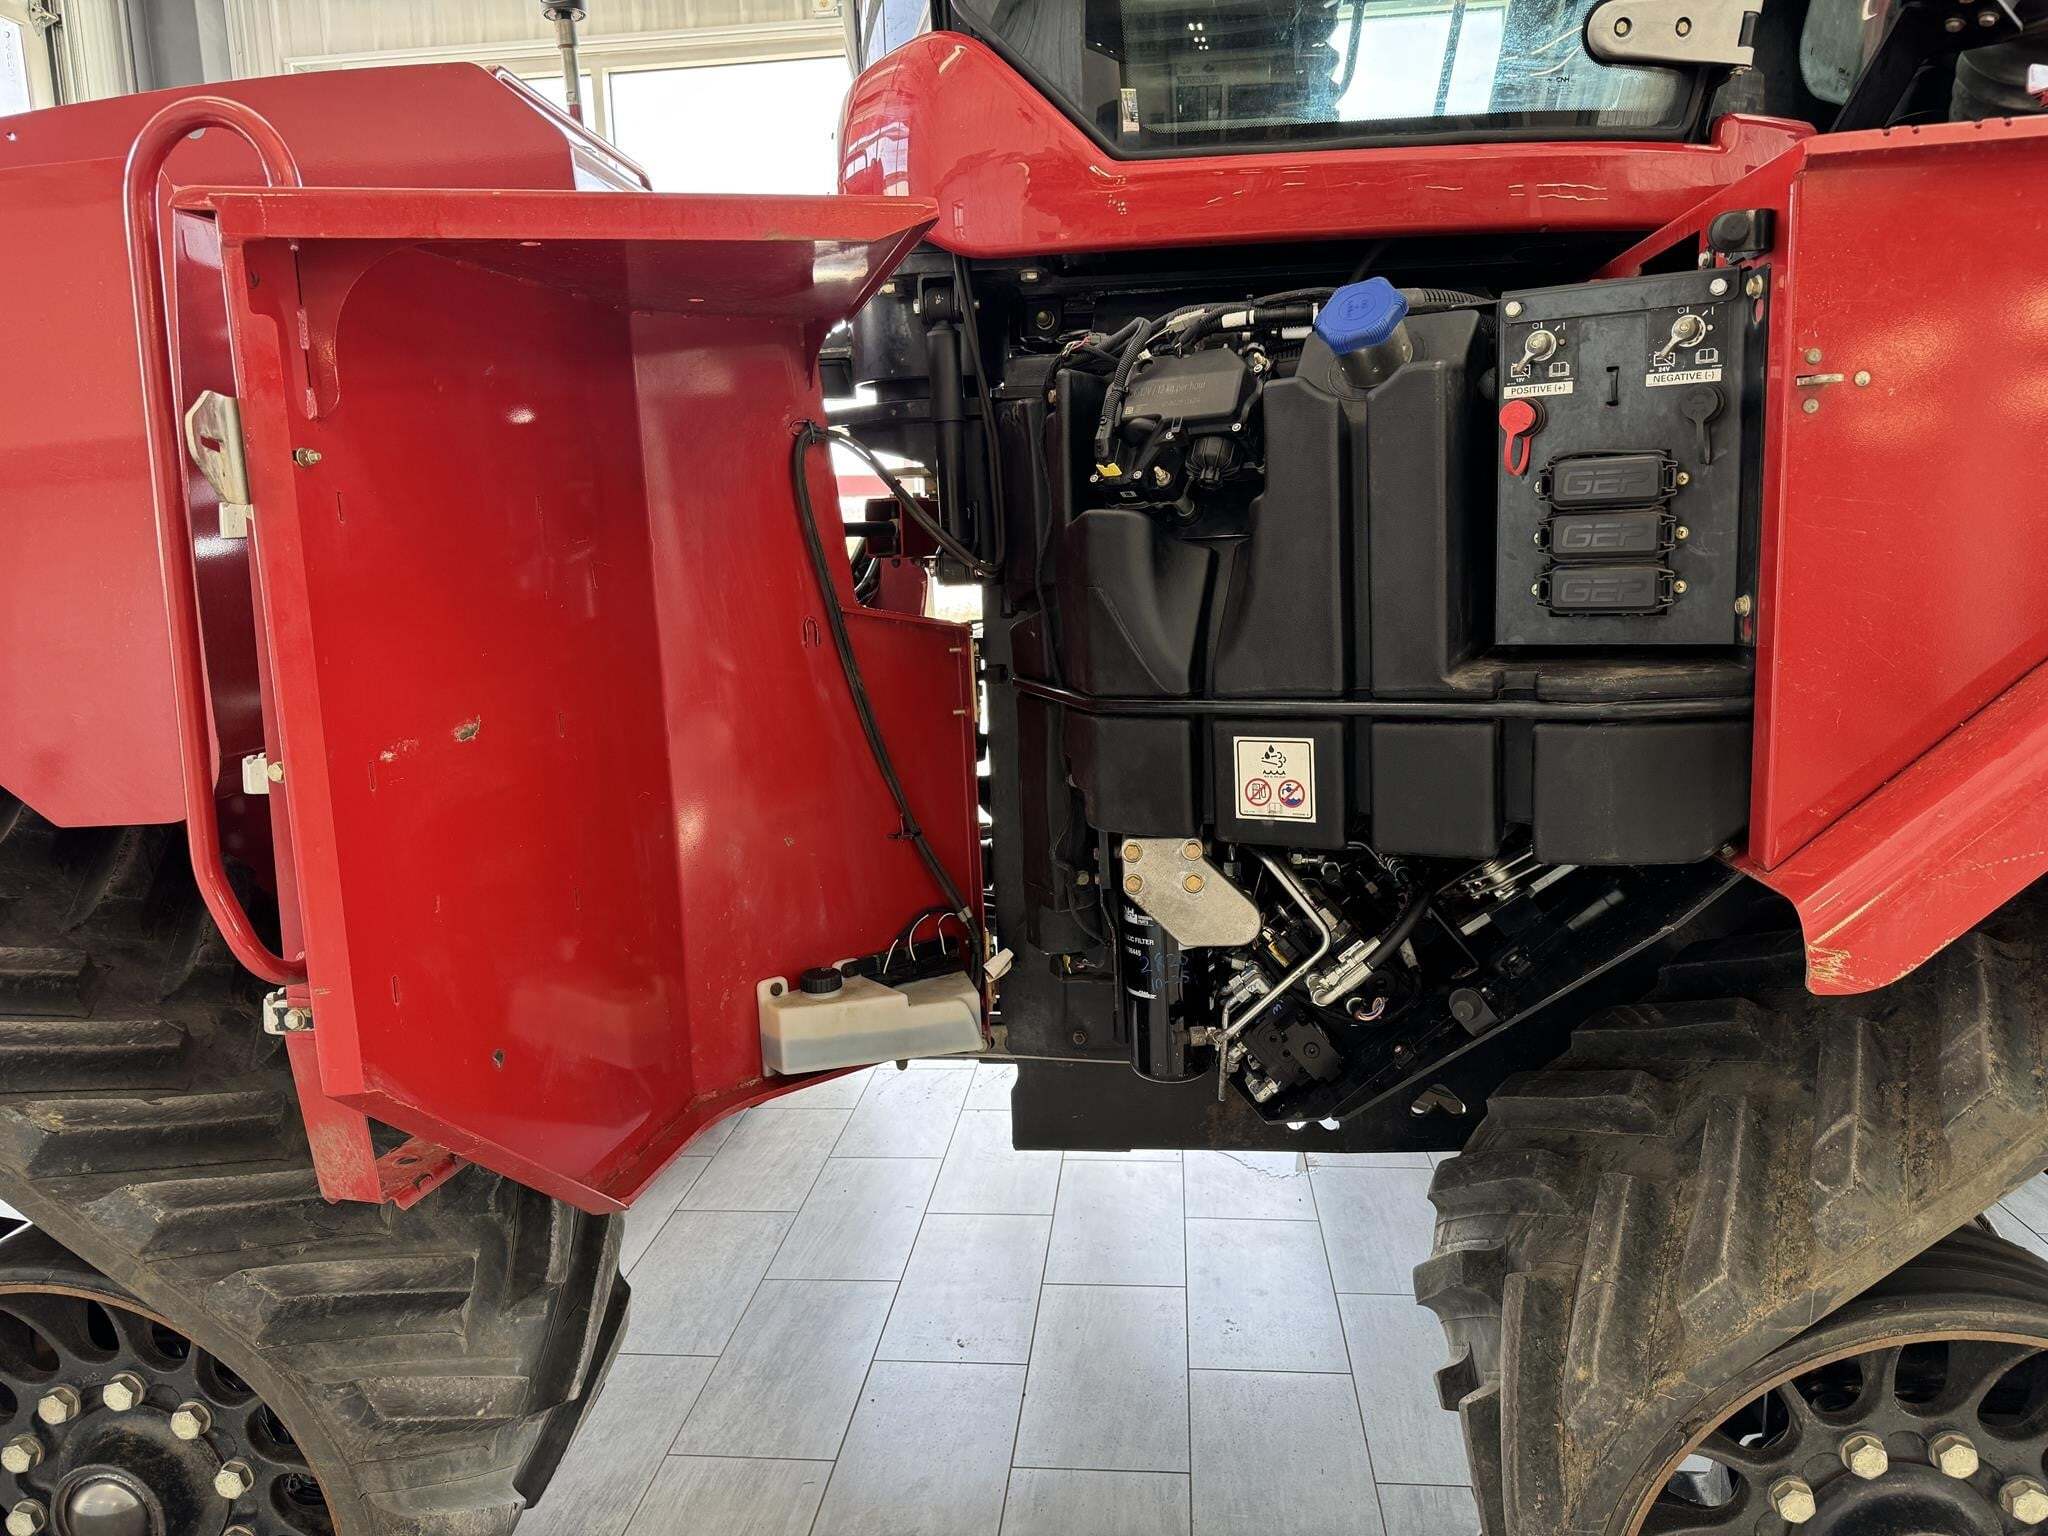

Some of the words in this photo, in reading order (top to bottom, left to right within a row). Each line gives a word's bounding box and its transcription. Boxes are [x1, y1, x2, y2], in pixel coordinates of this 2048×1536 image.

[1653, 372, 1702, 383] NEGATIVE
[1511, 384, 1552, 395] POSITIVE
[1554, 383, 1566, 393] (+)
[1135, 937, 1155, 946] FILTER
